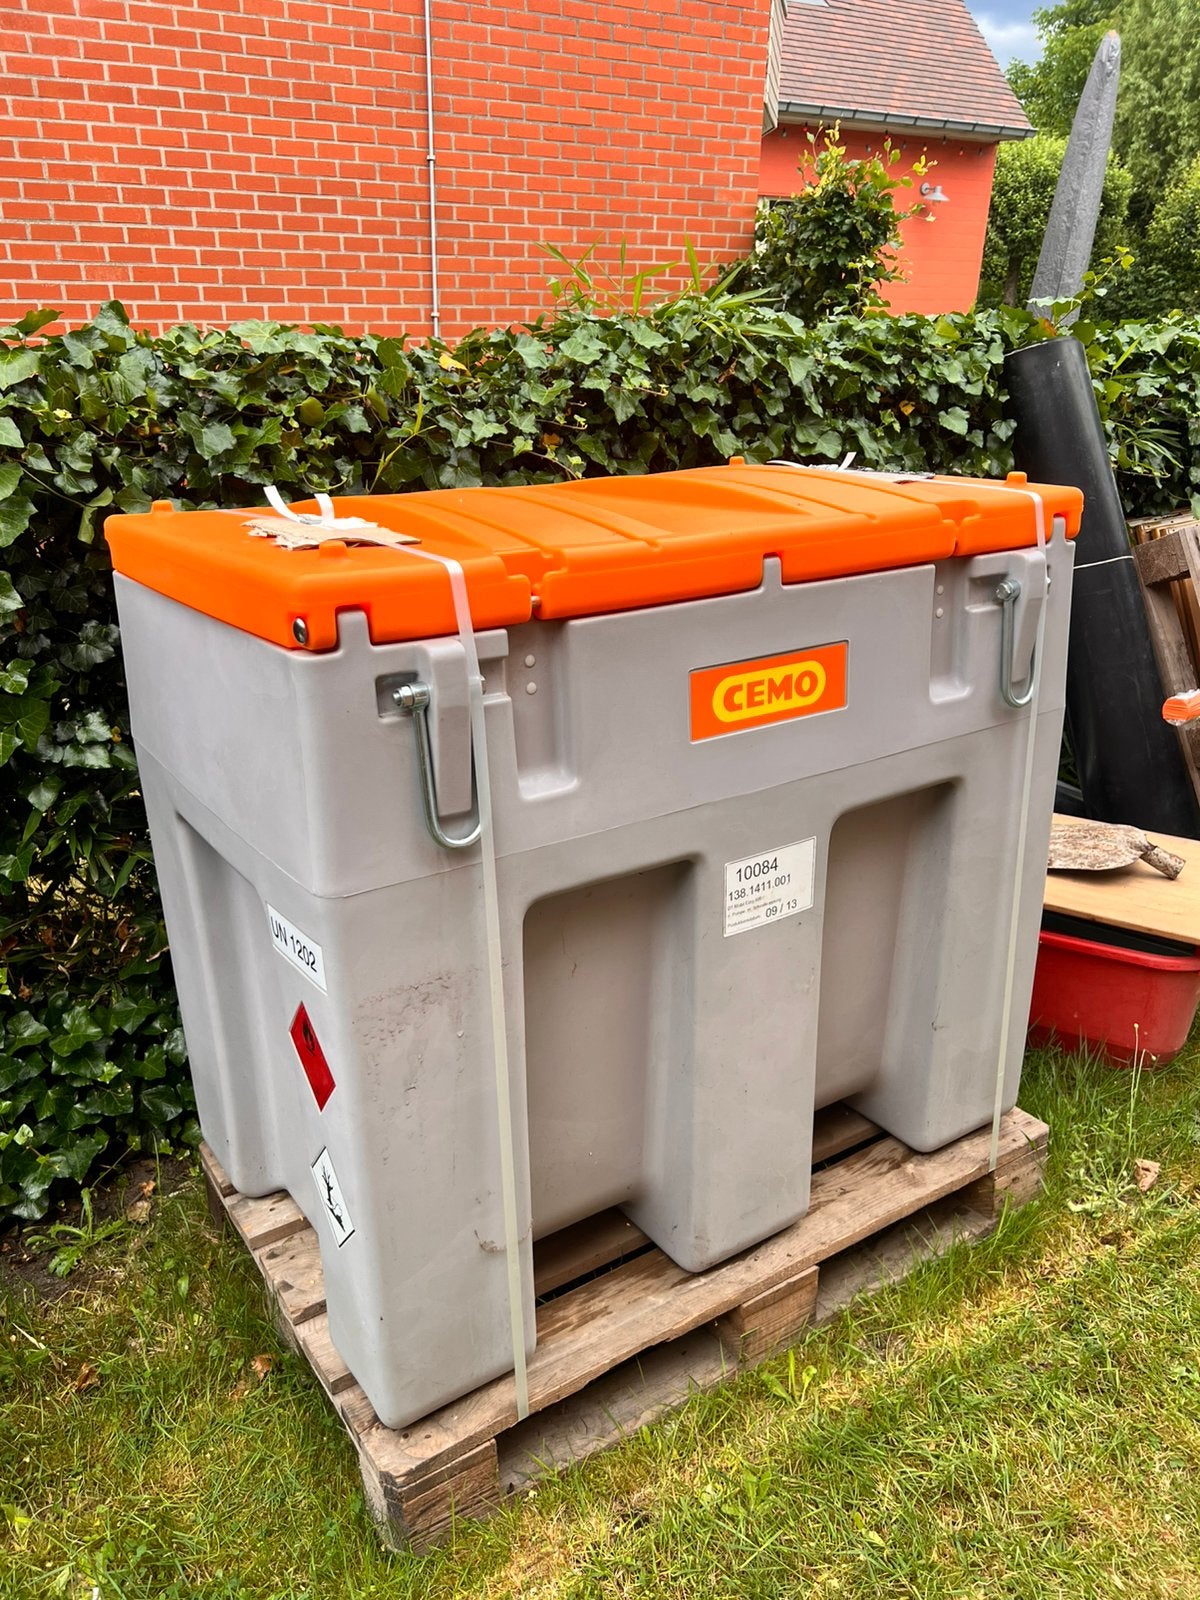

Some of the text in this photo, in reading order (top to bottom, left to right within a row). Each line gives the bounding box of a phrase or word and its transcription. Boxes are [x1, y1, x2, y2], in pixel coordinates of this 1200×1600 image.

[723, 670, 818, 713] CEMO
[736, 857, 778, 882] 10084
[728, 873, 791, 901] 138.1411.001
[765, 905, 778, 918] 09
[786, 898, 797, 910] 13
[270, 916, 317, 973] UN 1202
